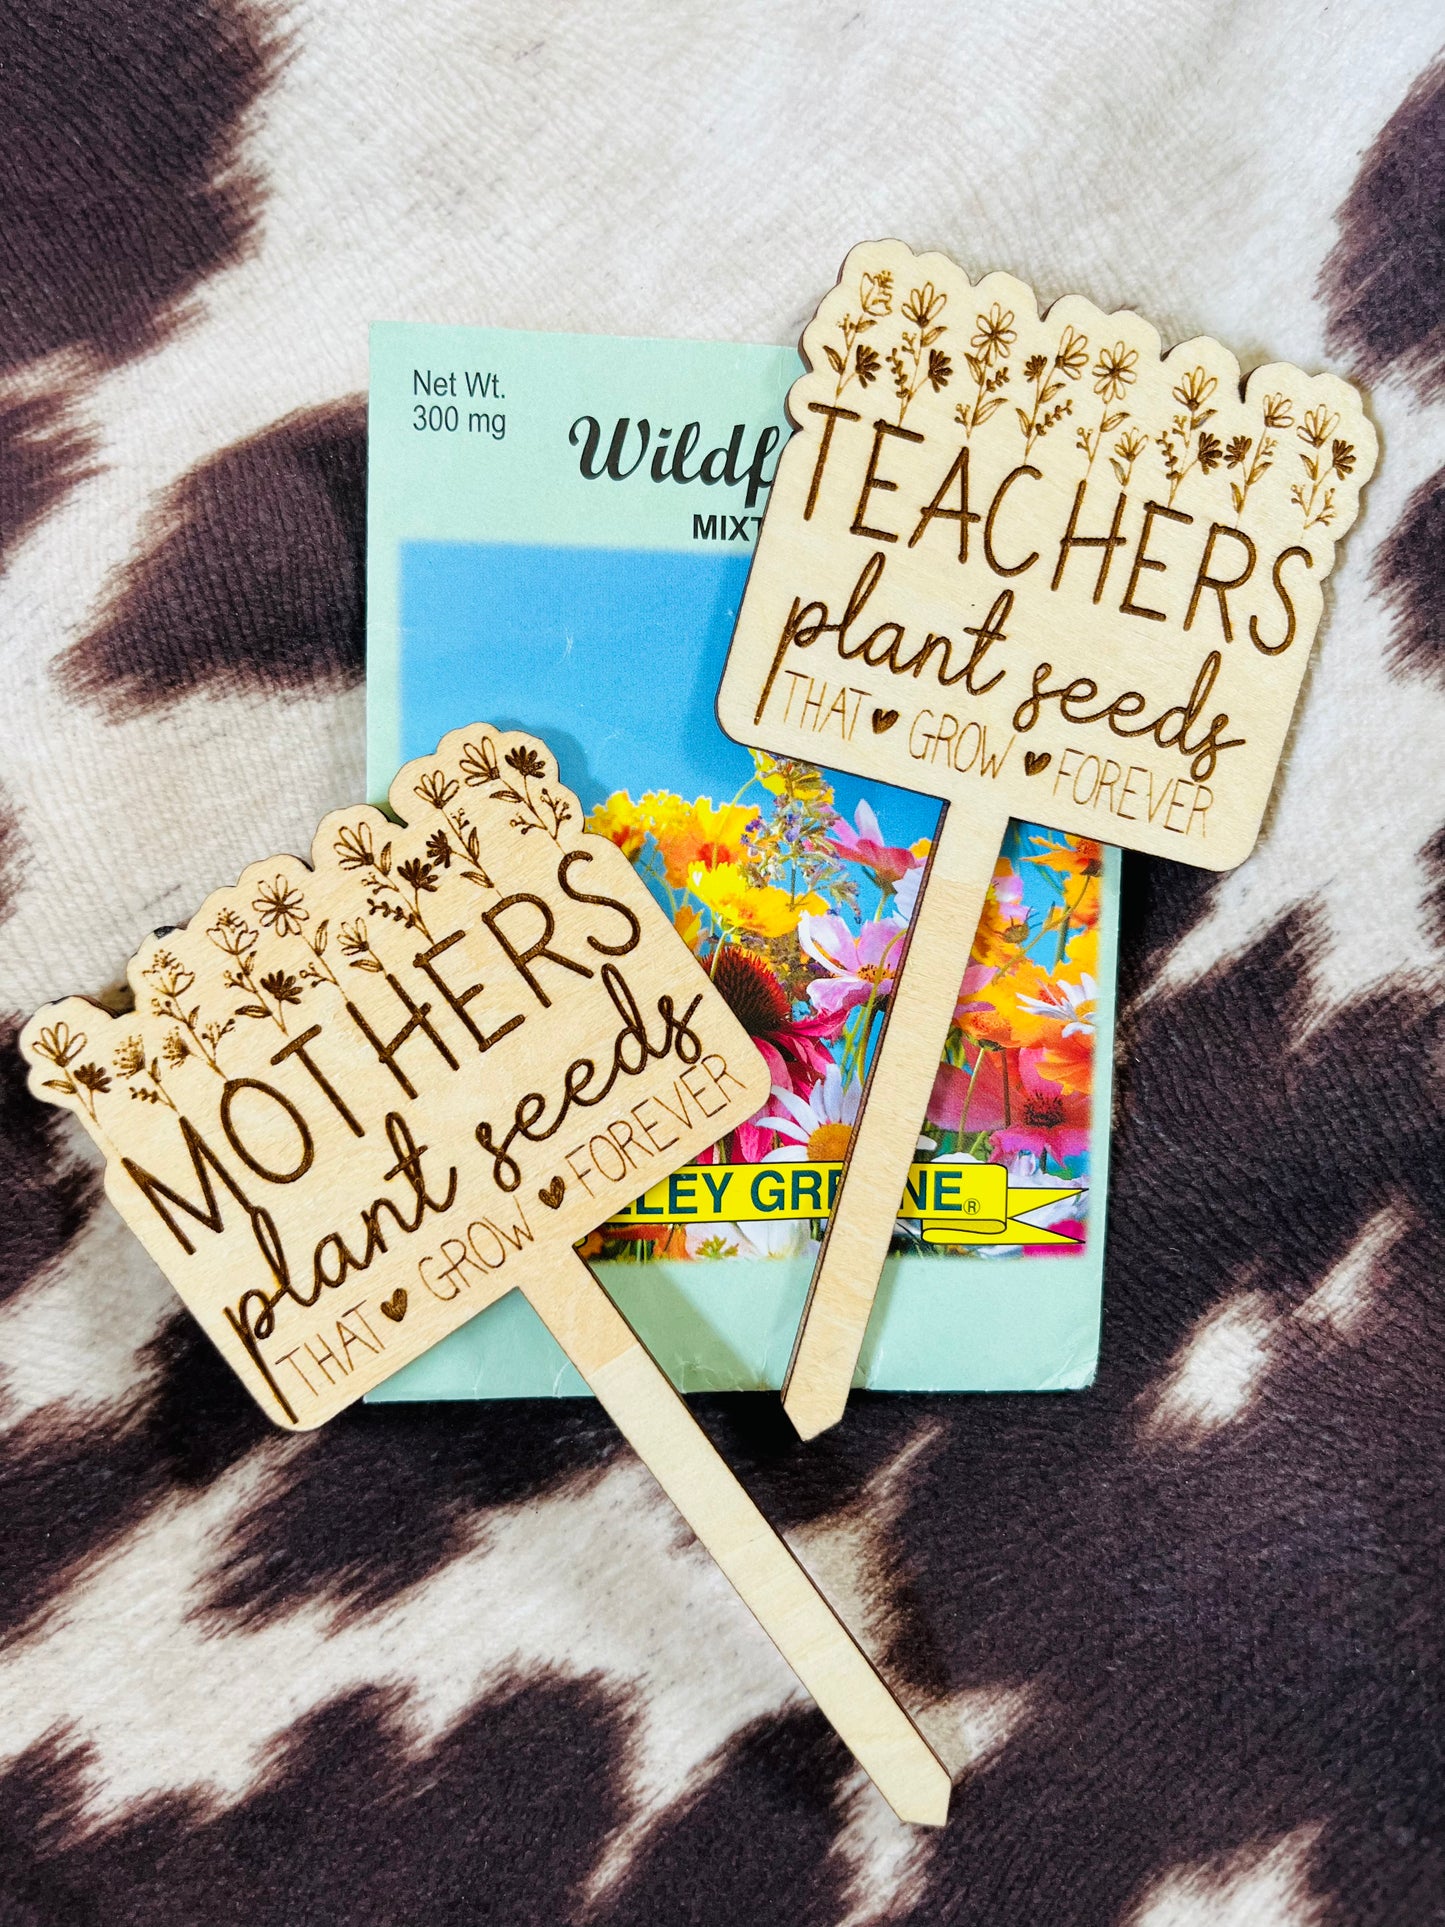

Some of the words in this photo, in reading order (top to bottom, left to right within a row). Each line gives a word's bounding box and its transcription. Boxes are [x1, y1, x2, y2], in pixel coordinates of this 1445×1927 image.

[412, 404, 459, 433] 300
[468, 412, 506, 440] mg
[413, 369, 457, 397] Net
[464, 371, 506, 399] Wt.
[803, 401, 1314, 657] TEACHERS
[753, 551, 1016, 727] plant
[1012, 650, 1247, 782] seeds
[784, 669, 873, 741] THAT
[908, 708, 1018, 780] GROW
[1053, 747, 1217, 838] FOREVER
[121, 849, 641, 1256] MOTHERS
[223, 1111, 457, 1425] plant
[475, 963, 704, 1193] seeds
[274, 1299, 387, 1398] THAT
[417, 1198, 536, 1303] GROW
[566, 1053, 747, 1200] FOREVER
